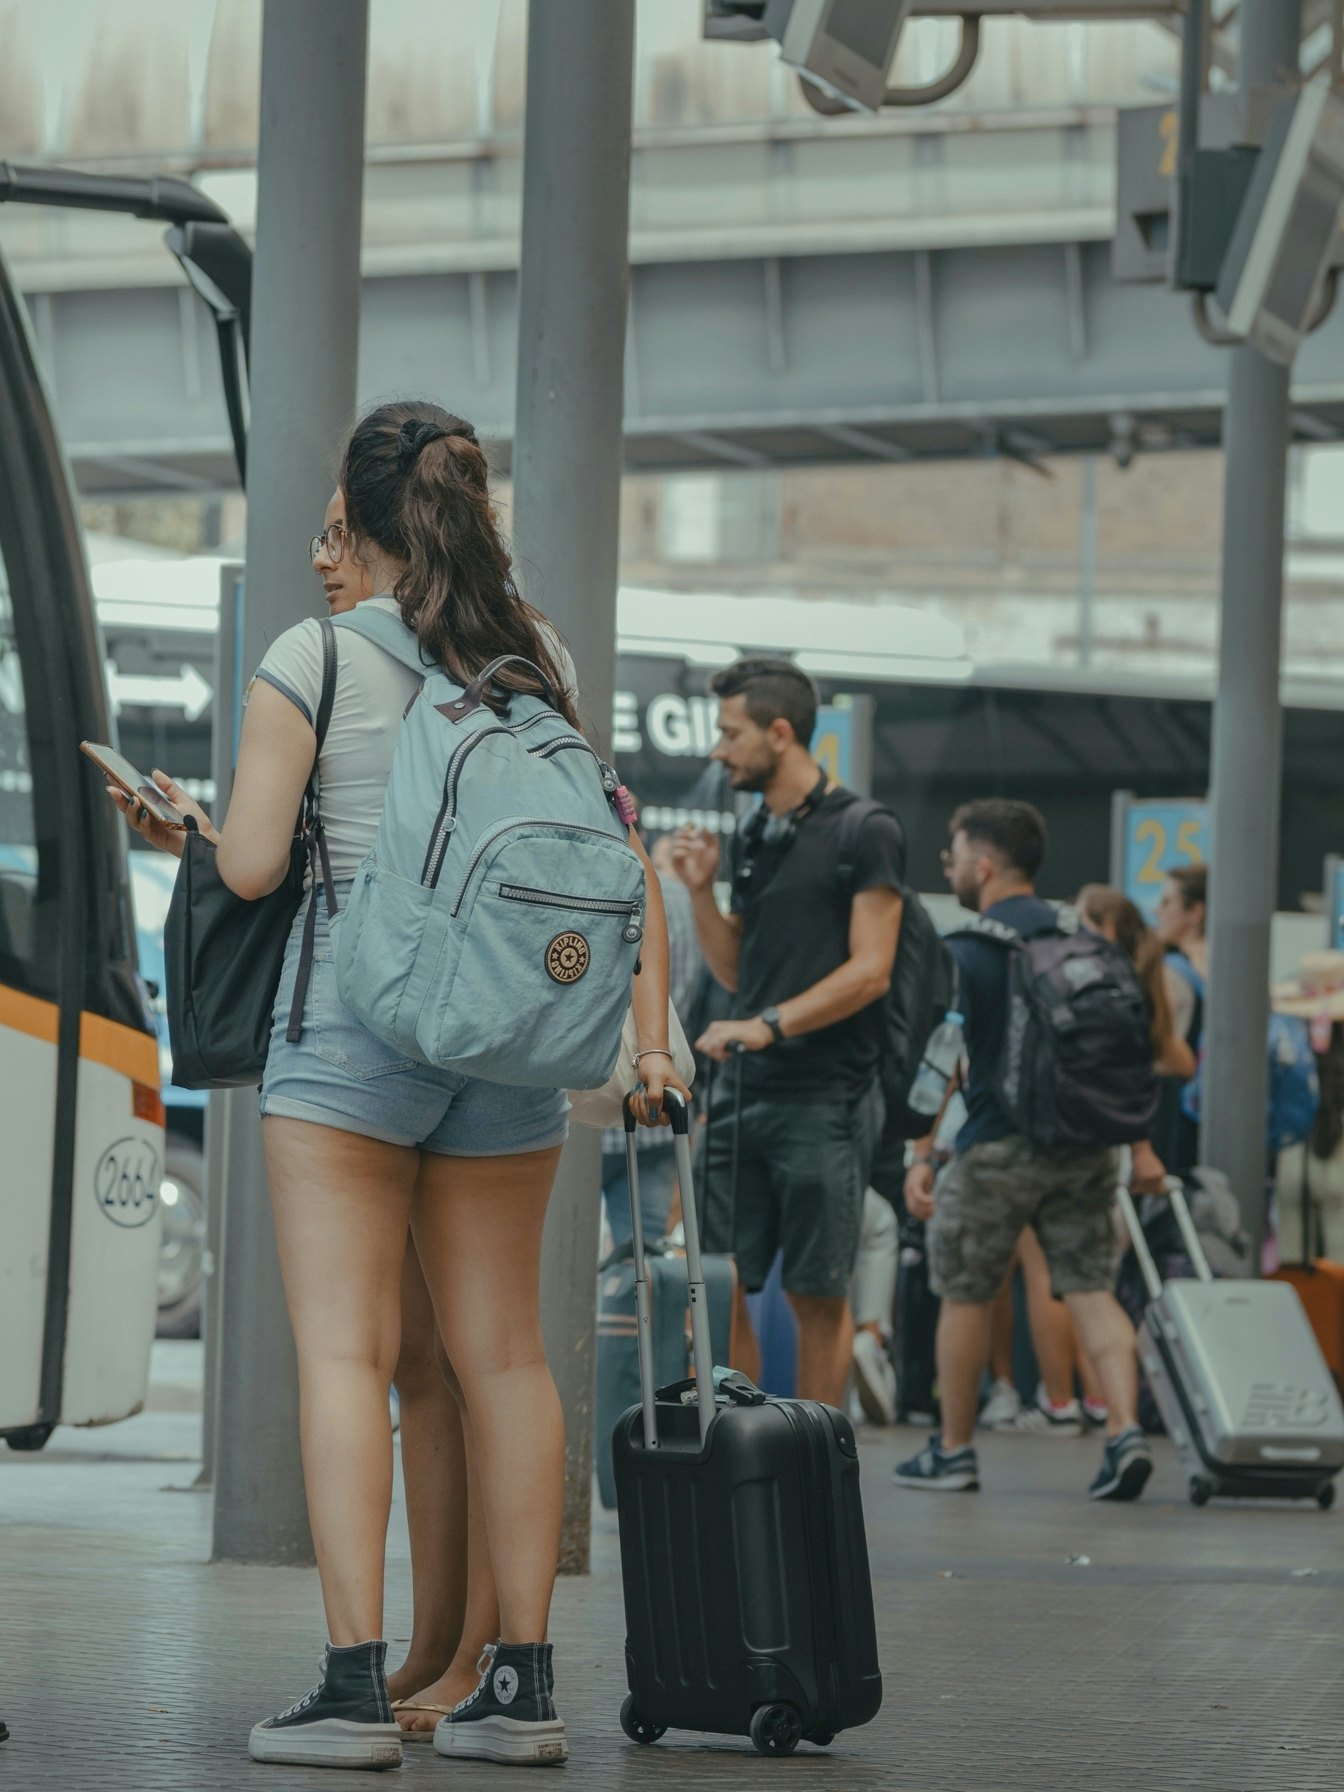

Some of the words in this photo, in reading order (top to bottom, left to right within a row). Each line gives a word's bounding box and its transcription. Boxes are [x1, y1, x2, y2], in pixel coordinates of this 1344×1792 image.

[1135, 819, 1203, 883] 25
[554, 936, 586, 955] KIPLING
[551, 960, 583, 979] KIPLING
[103, 1156, 157, 1208] 2664
